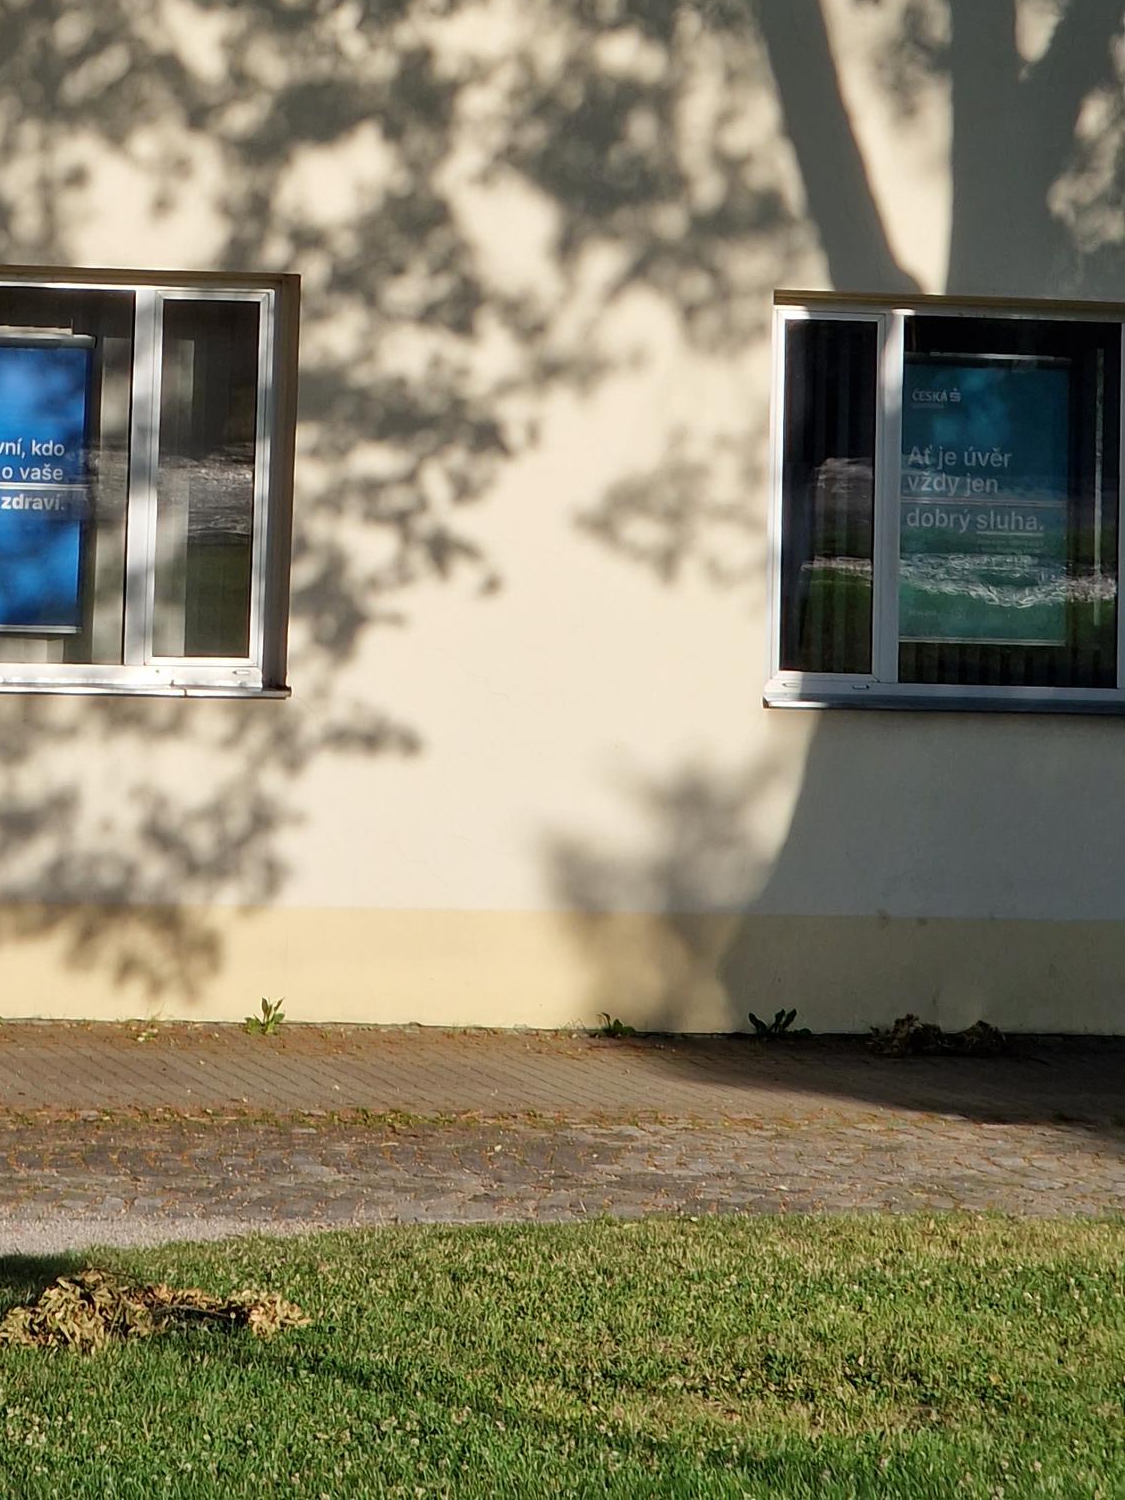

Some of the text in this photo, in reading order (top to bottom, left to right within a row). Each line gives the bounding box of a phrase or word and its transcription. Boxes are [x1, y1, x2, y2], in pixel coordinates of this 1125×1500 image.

[31, 439, 65, 457] kdo
[907, 445, 1013, 470] Ať je úvěr
[1, 466, 14, 479] o
[19, 463, 64, 480] vaše
[907, 471, 999, 497] vždy jen
[1, 493, 65, 511] zdraví.
[906, 508, 1044, 533] dobrý sluha.
